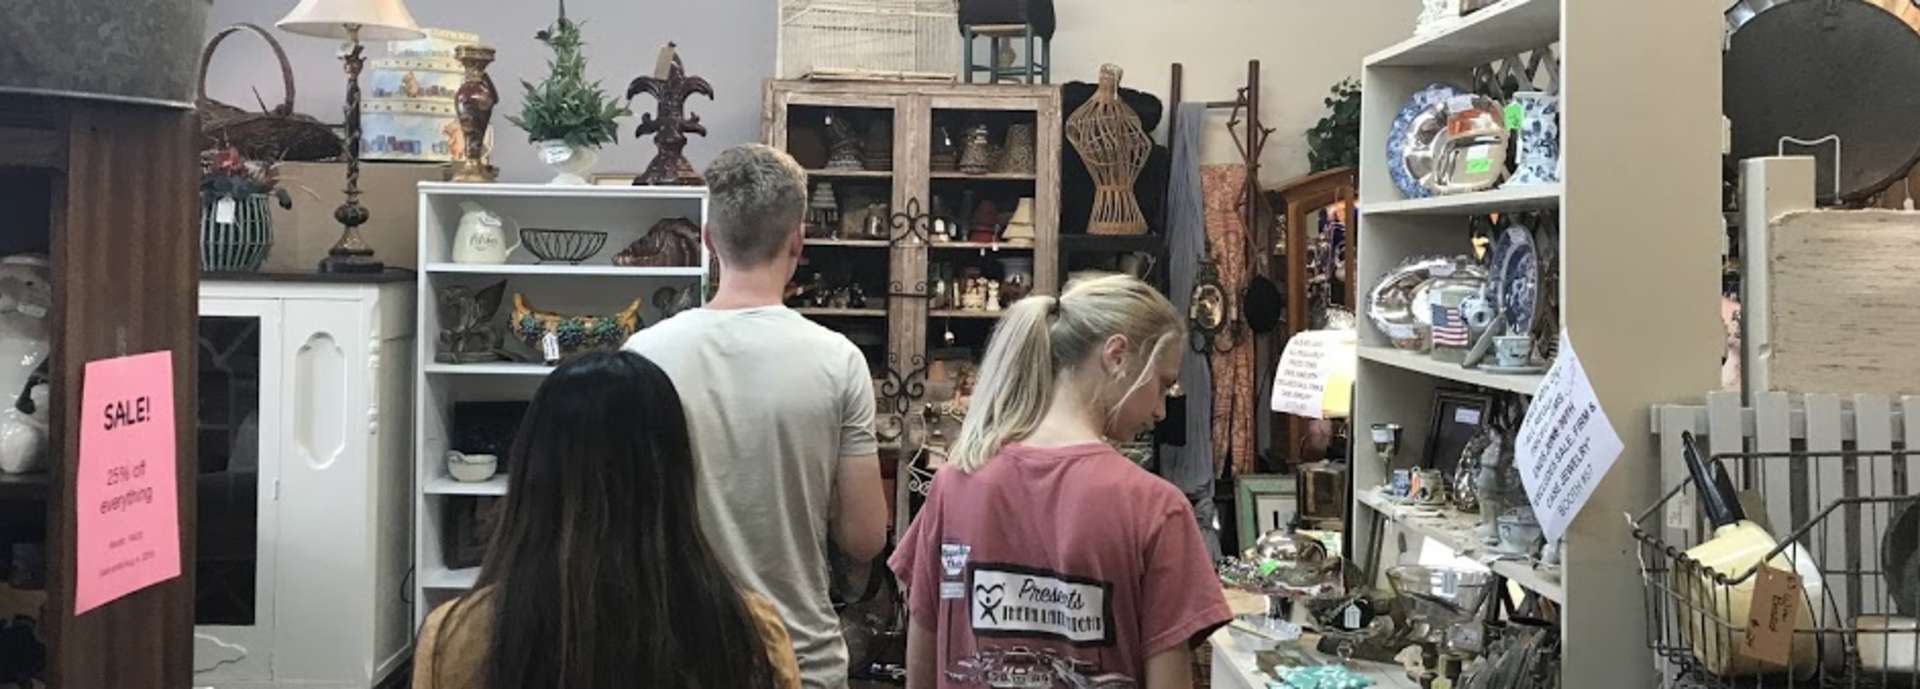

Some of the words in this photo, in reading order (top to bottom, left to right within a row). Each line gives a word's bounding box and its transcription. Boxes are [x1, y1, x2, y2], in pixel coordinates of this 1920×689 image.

[103, 395, 151, 431] SALE!
[1573, 408, 1591, 437] FIRM
[106, 466, 131, 486] 25%
[132, 459, 147, 479] off
[100, 486, 152, 514] everything
[1546, 481, 1562, 510] CASE
[1557, 480, 1585, 518] BOOTH
[1018, 578, 1085, 610] Presents
